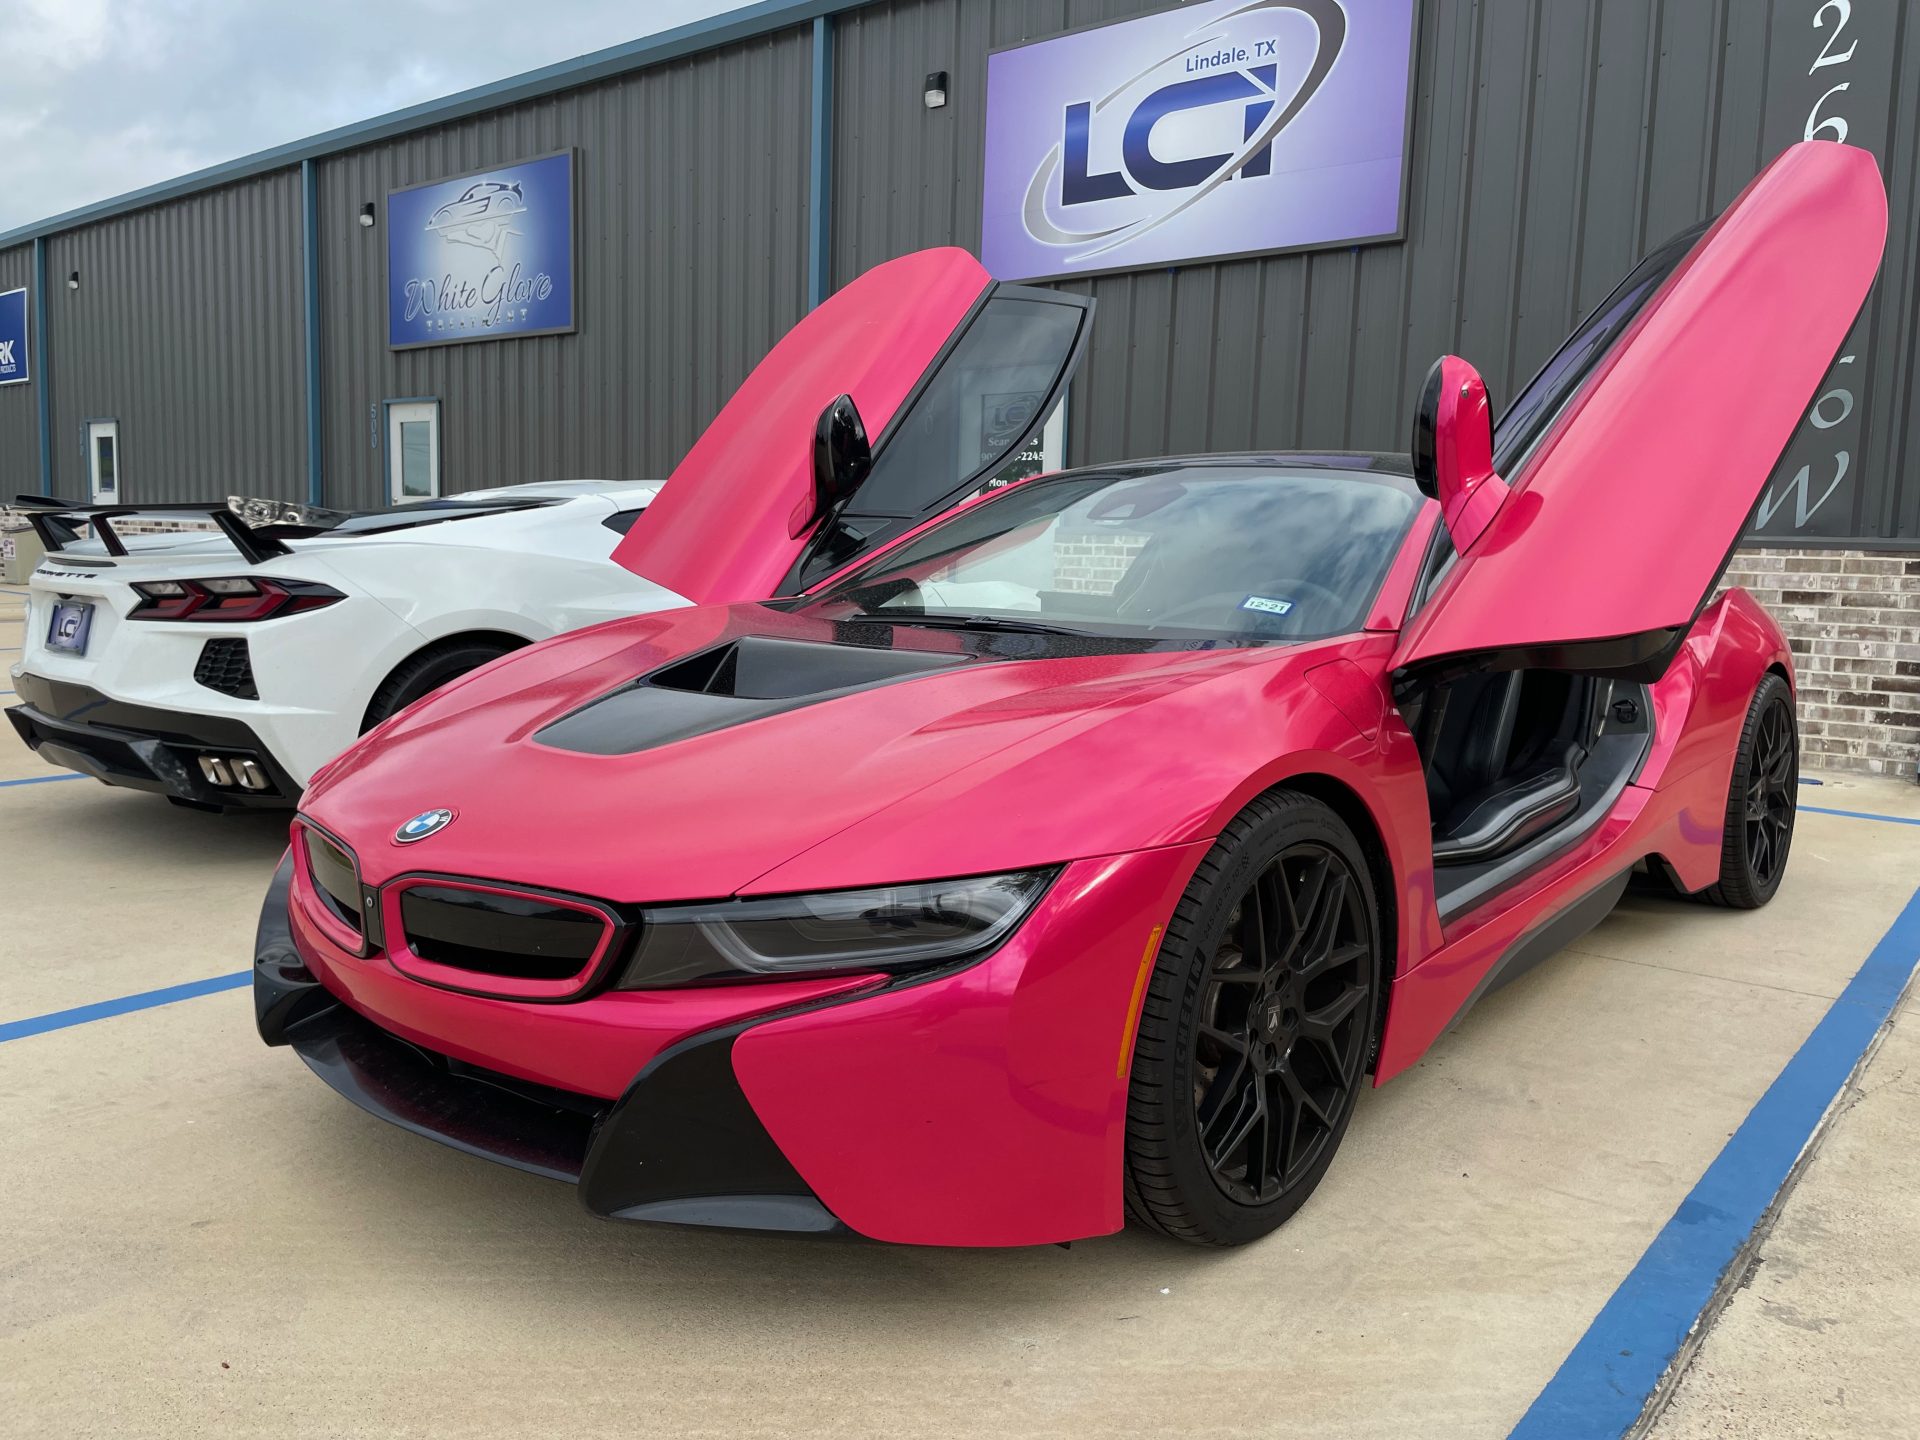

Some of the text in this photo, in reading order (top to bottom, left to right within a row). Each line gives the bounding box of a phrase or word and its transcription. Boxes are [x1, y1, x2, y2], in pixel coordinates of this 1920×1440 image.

[1185, 39, 1278, 73] Lindale, TX
[405, 263, 552, 327] White Glove
